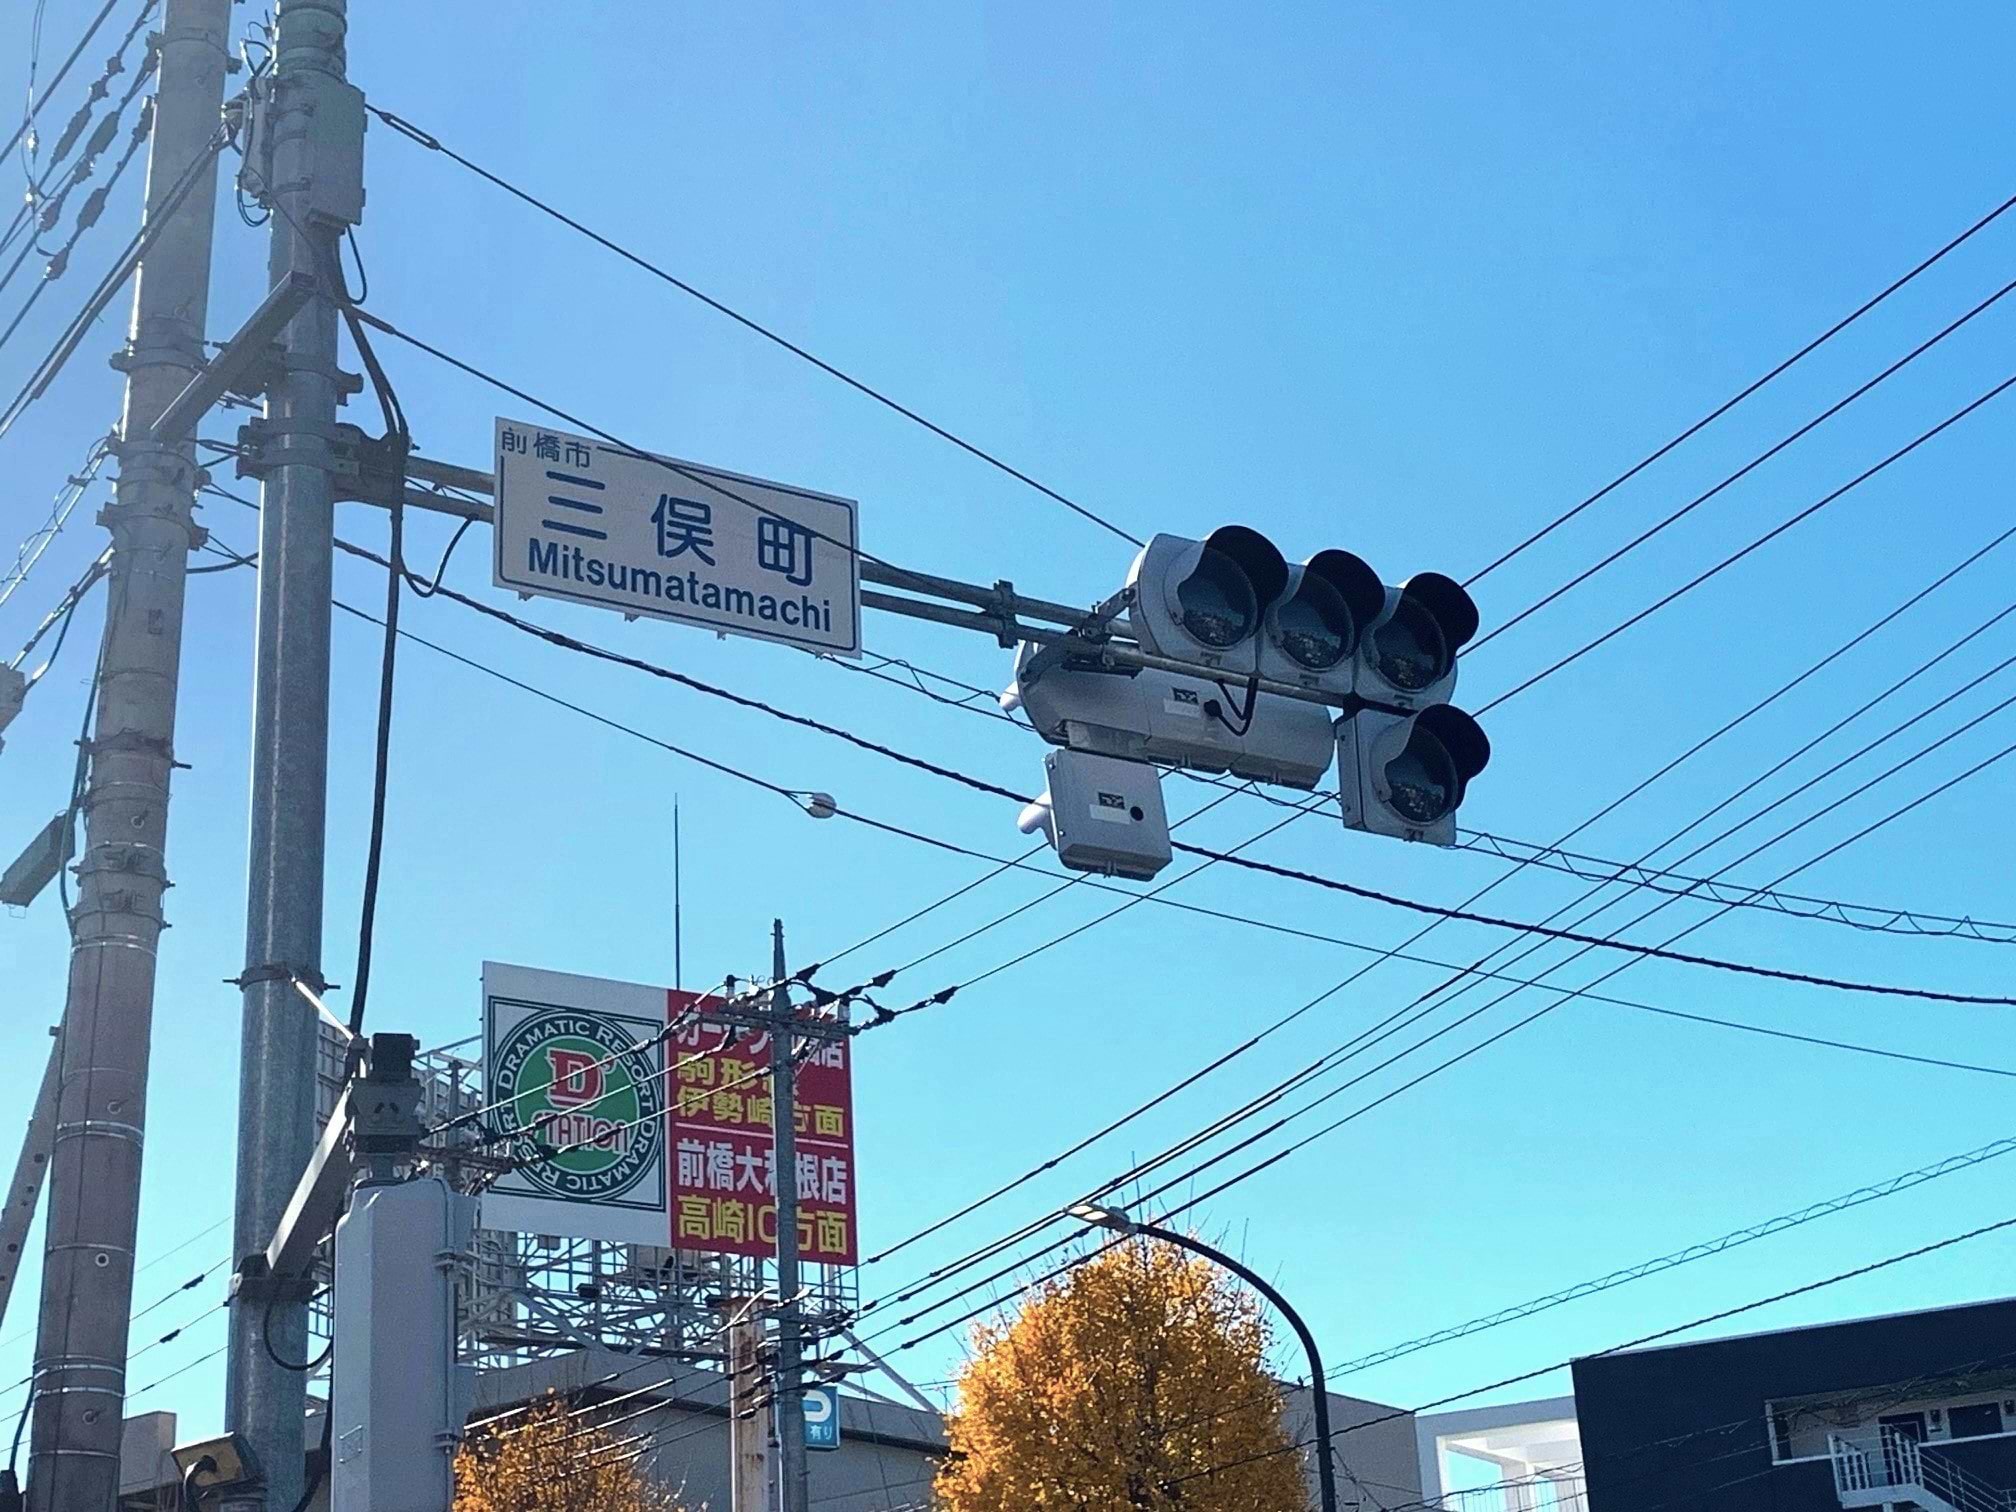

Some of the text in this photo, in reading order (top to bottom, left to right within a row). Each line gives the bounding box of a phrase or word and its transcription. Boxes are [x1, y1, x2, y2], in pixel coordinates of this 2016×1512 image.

[501, 427, 592, 468] 前橋市
[542, 470, 817, 587] 三俣町
[528, 537, 831, 632] Mitsumatamachi
[498, 1020, 654, 1111] DRAMATIC RESORT
[566, 1121, 656, 1190] DRAMATIC
